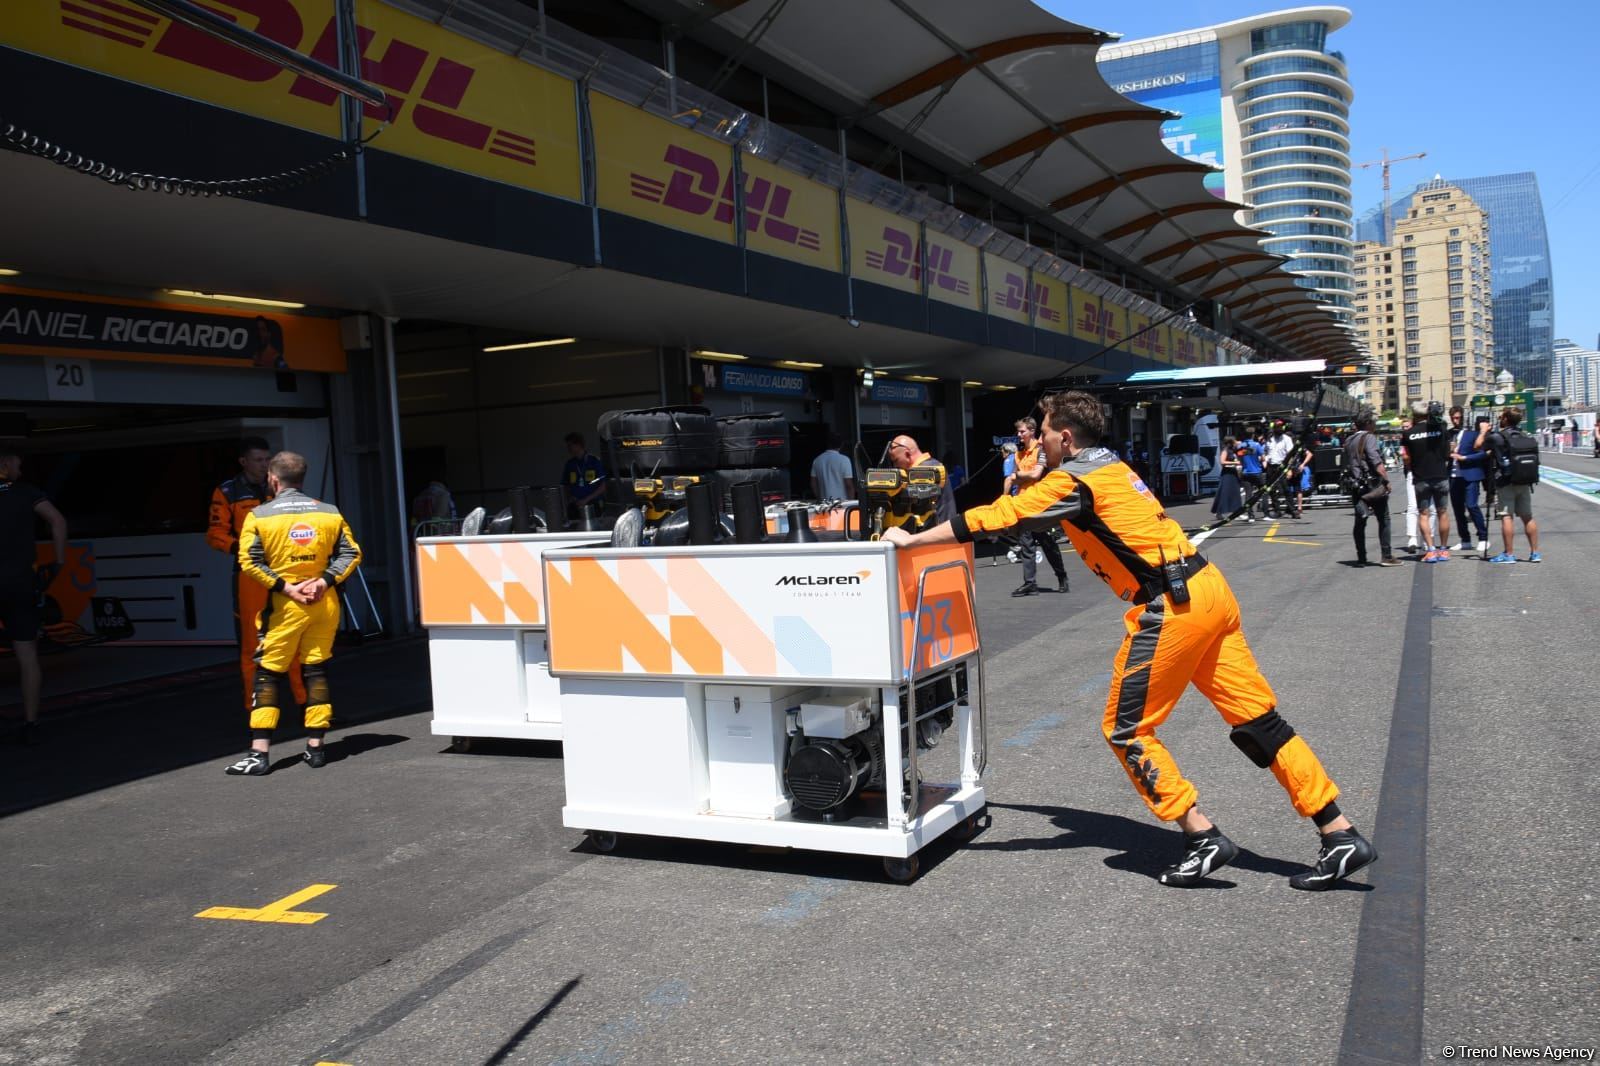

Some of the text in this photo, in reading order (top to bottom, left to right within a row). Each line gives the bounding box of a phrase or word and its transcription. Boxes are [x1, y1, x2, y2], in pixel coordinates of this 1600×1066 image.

[153, 0, 492, 150] DHL
[662, 144, 799, 245] DHL
[882, 226, 959, 292] DHL
[1005, 272, 1053, 320] DHL
[101, 317, 249, 351] RICCIARDO
[1083, 302, 1116, 340] DHL
[55, 365, 84, 387] 20
[702, 364, 717, 388] 14
[725, 371, 803, 391] FERNANDO ALONSO
[1170, 456, 1185, 468] 22
[290, 530, 313, 539] Gulf
[775, 574, 861, 587] McLaren
